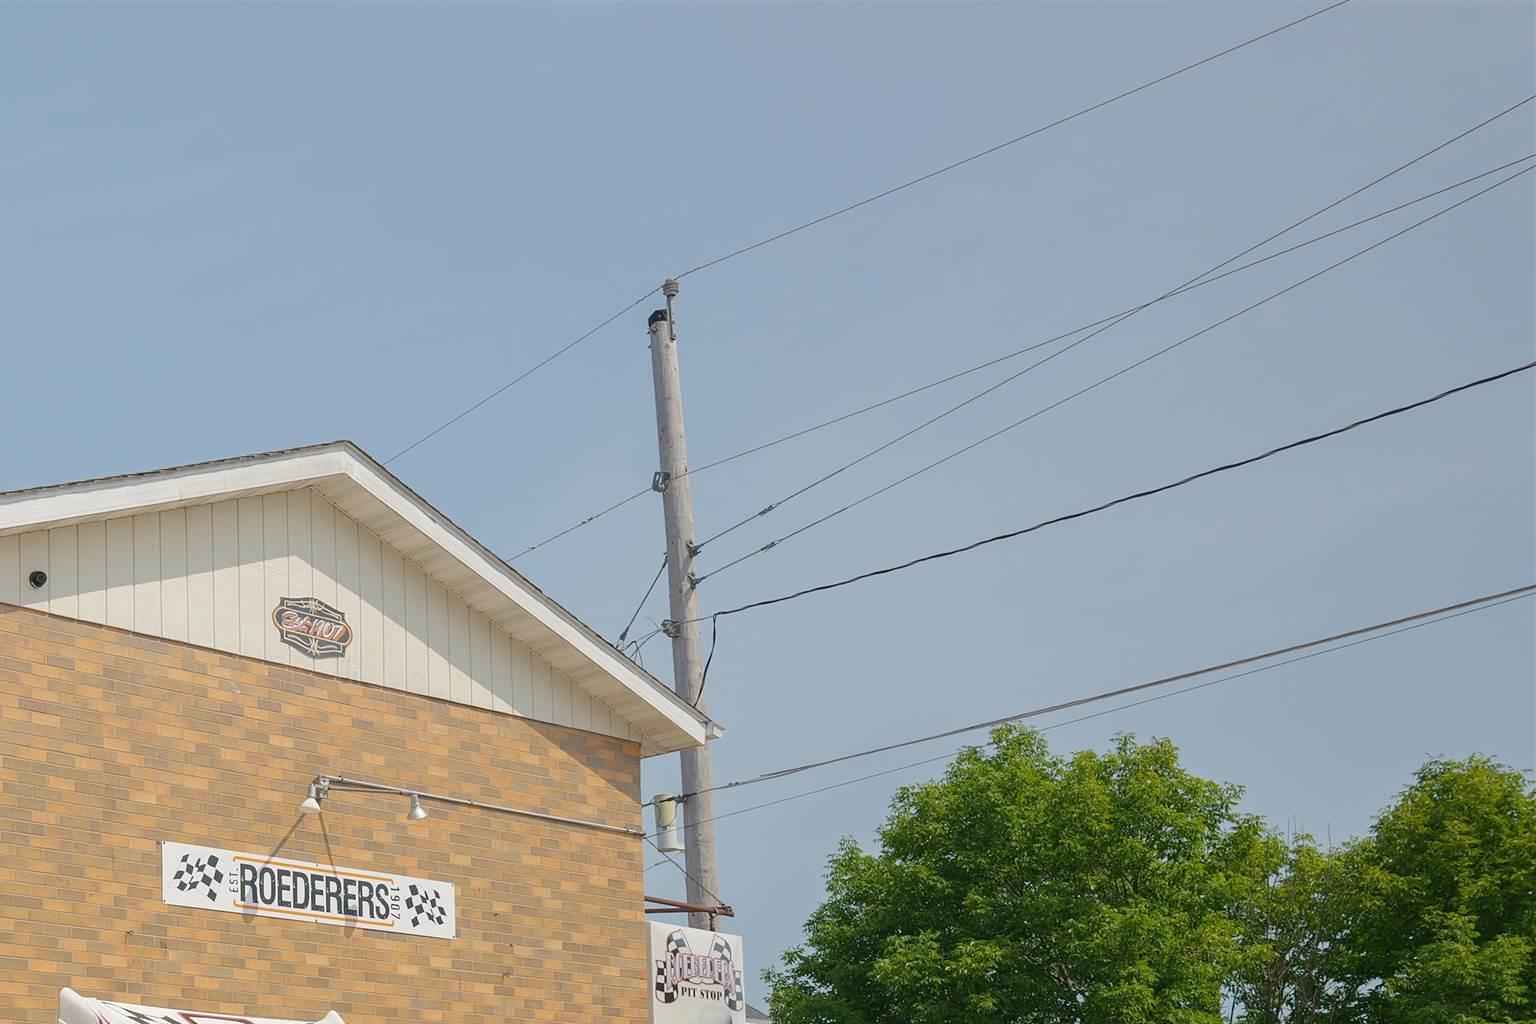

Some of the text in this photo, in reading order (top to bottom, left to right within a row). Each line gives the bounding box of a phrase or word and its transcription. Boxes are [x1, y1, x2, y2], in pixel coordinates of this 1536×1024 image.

[240, 863, 390, 920] ROEDERERS
[390, 887, 401, 920] 1907
[681, 986, 723, 1001] PIT STOP
